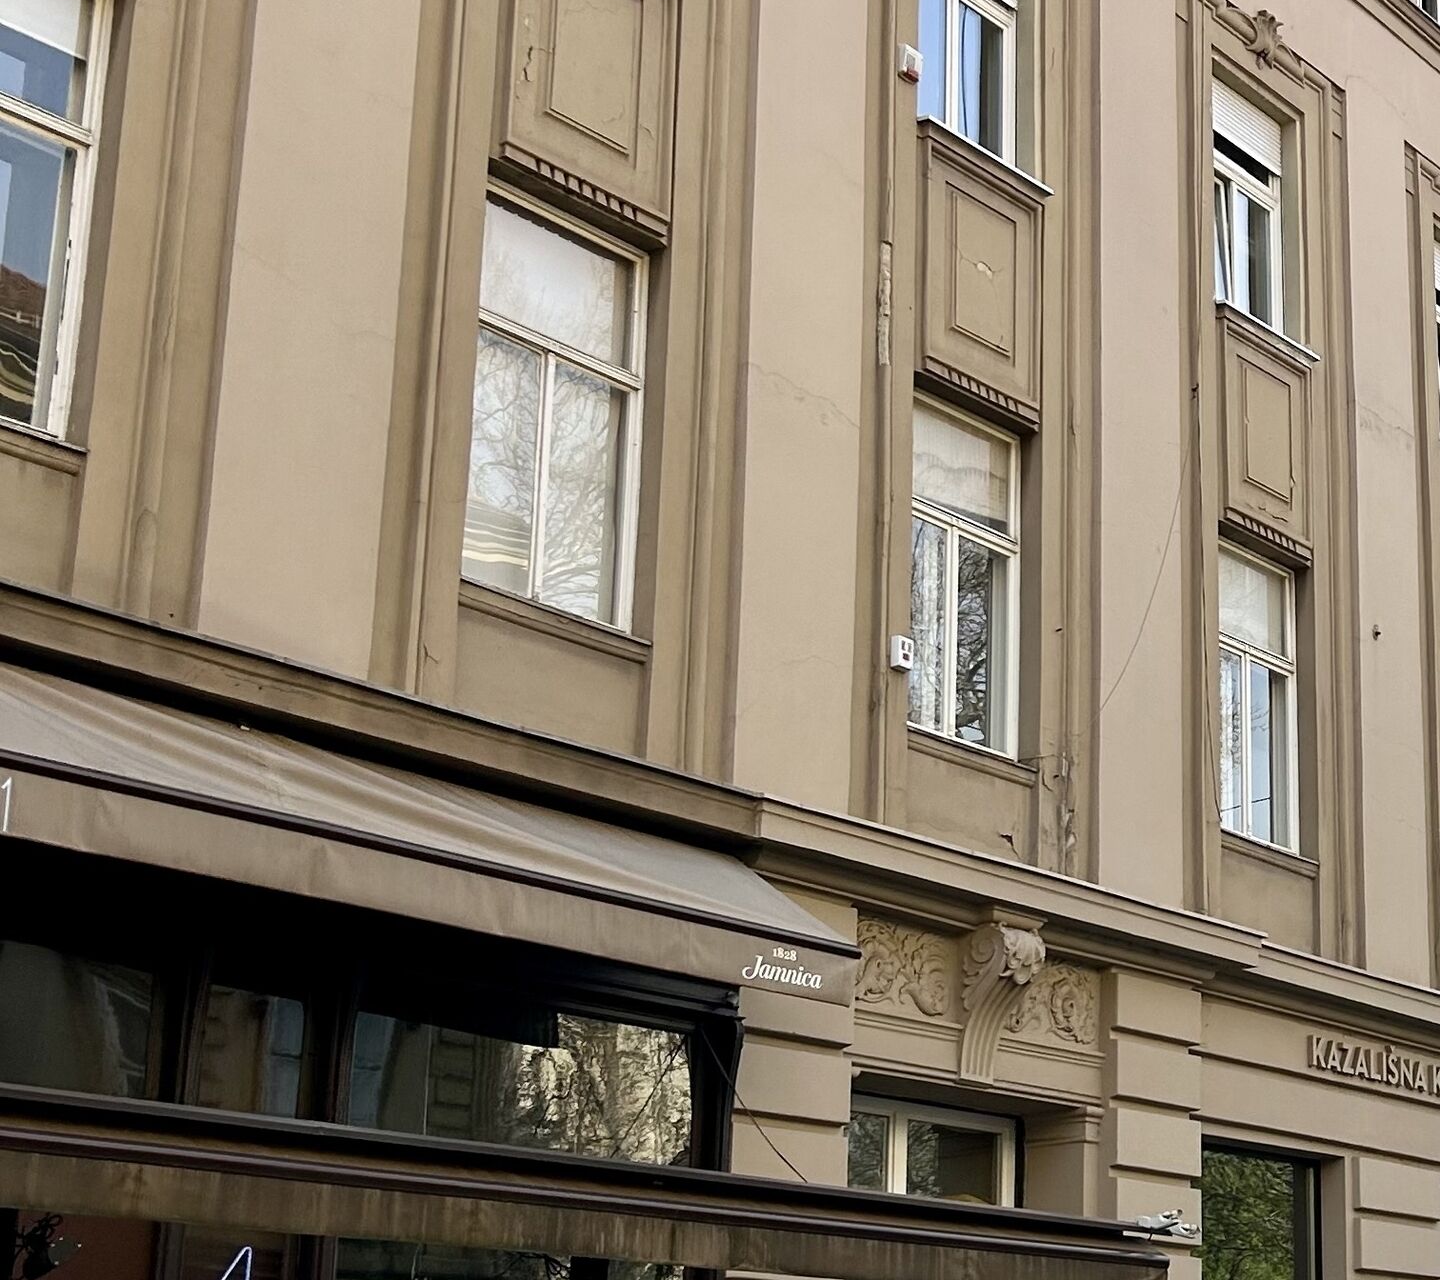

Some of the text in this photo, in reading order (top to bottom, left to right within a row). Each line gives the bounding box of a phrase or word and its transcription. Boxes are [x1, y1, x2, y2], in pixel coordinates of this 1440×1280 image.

[741, 954, 824, 990] Jamnica
[772, 946, 798, 962] 1828
[1307, 1034, 1428, 1092] KAZALIŠNA
